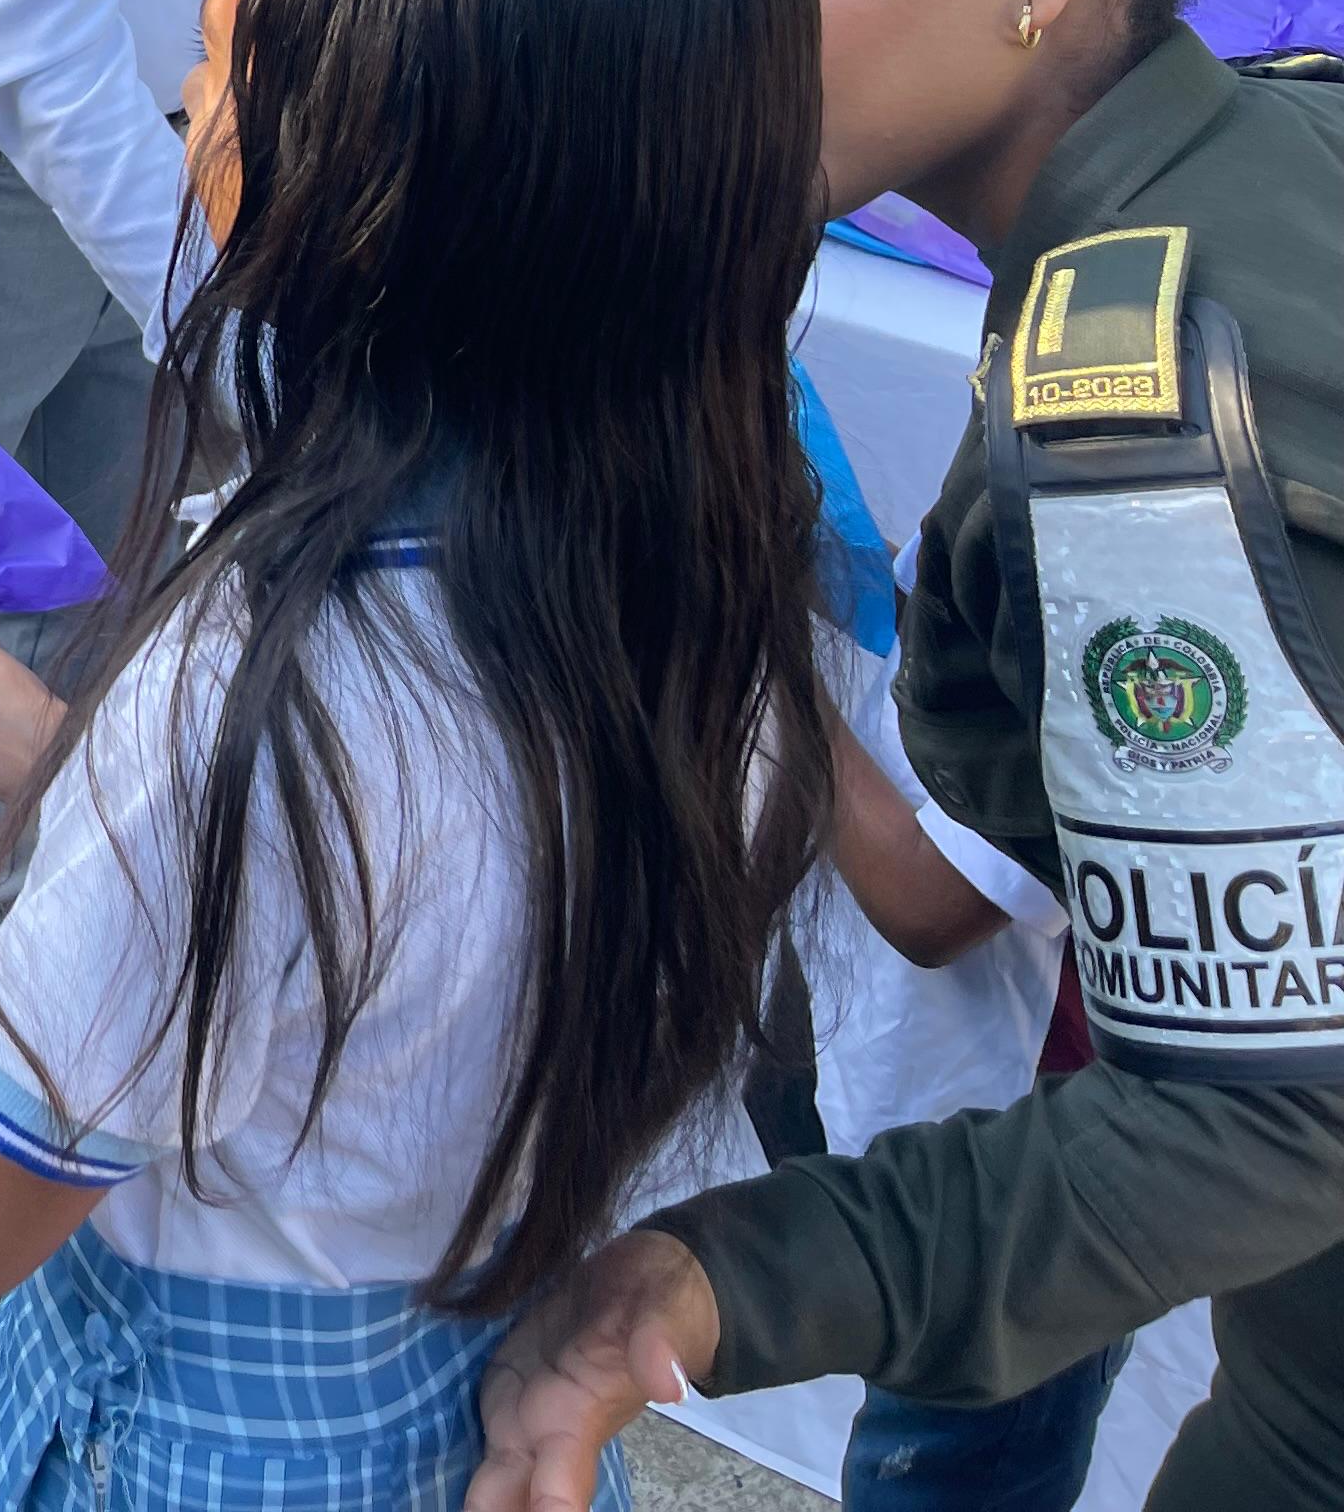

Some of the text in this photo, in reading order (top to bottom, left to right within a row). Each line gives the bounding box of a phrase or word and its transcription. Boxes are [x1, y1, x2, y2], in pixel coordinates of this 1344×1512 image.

[1029, 376, 1154, 406] 10-2023
[1143, 636, 1161, 645] DE
[1173, 641, 1222, 694] COLOMBIA
[1171, 714, 1221, 751] NACIONAL
[1170, 750, 1216, 770] PATRIA
[1077, 940, 1344, 1008] OMUNITAR
